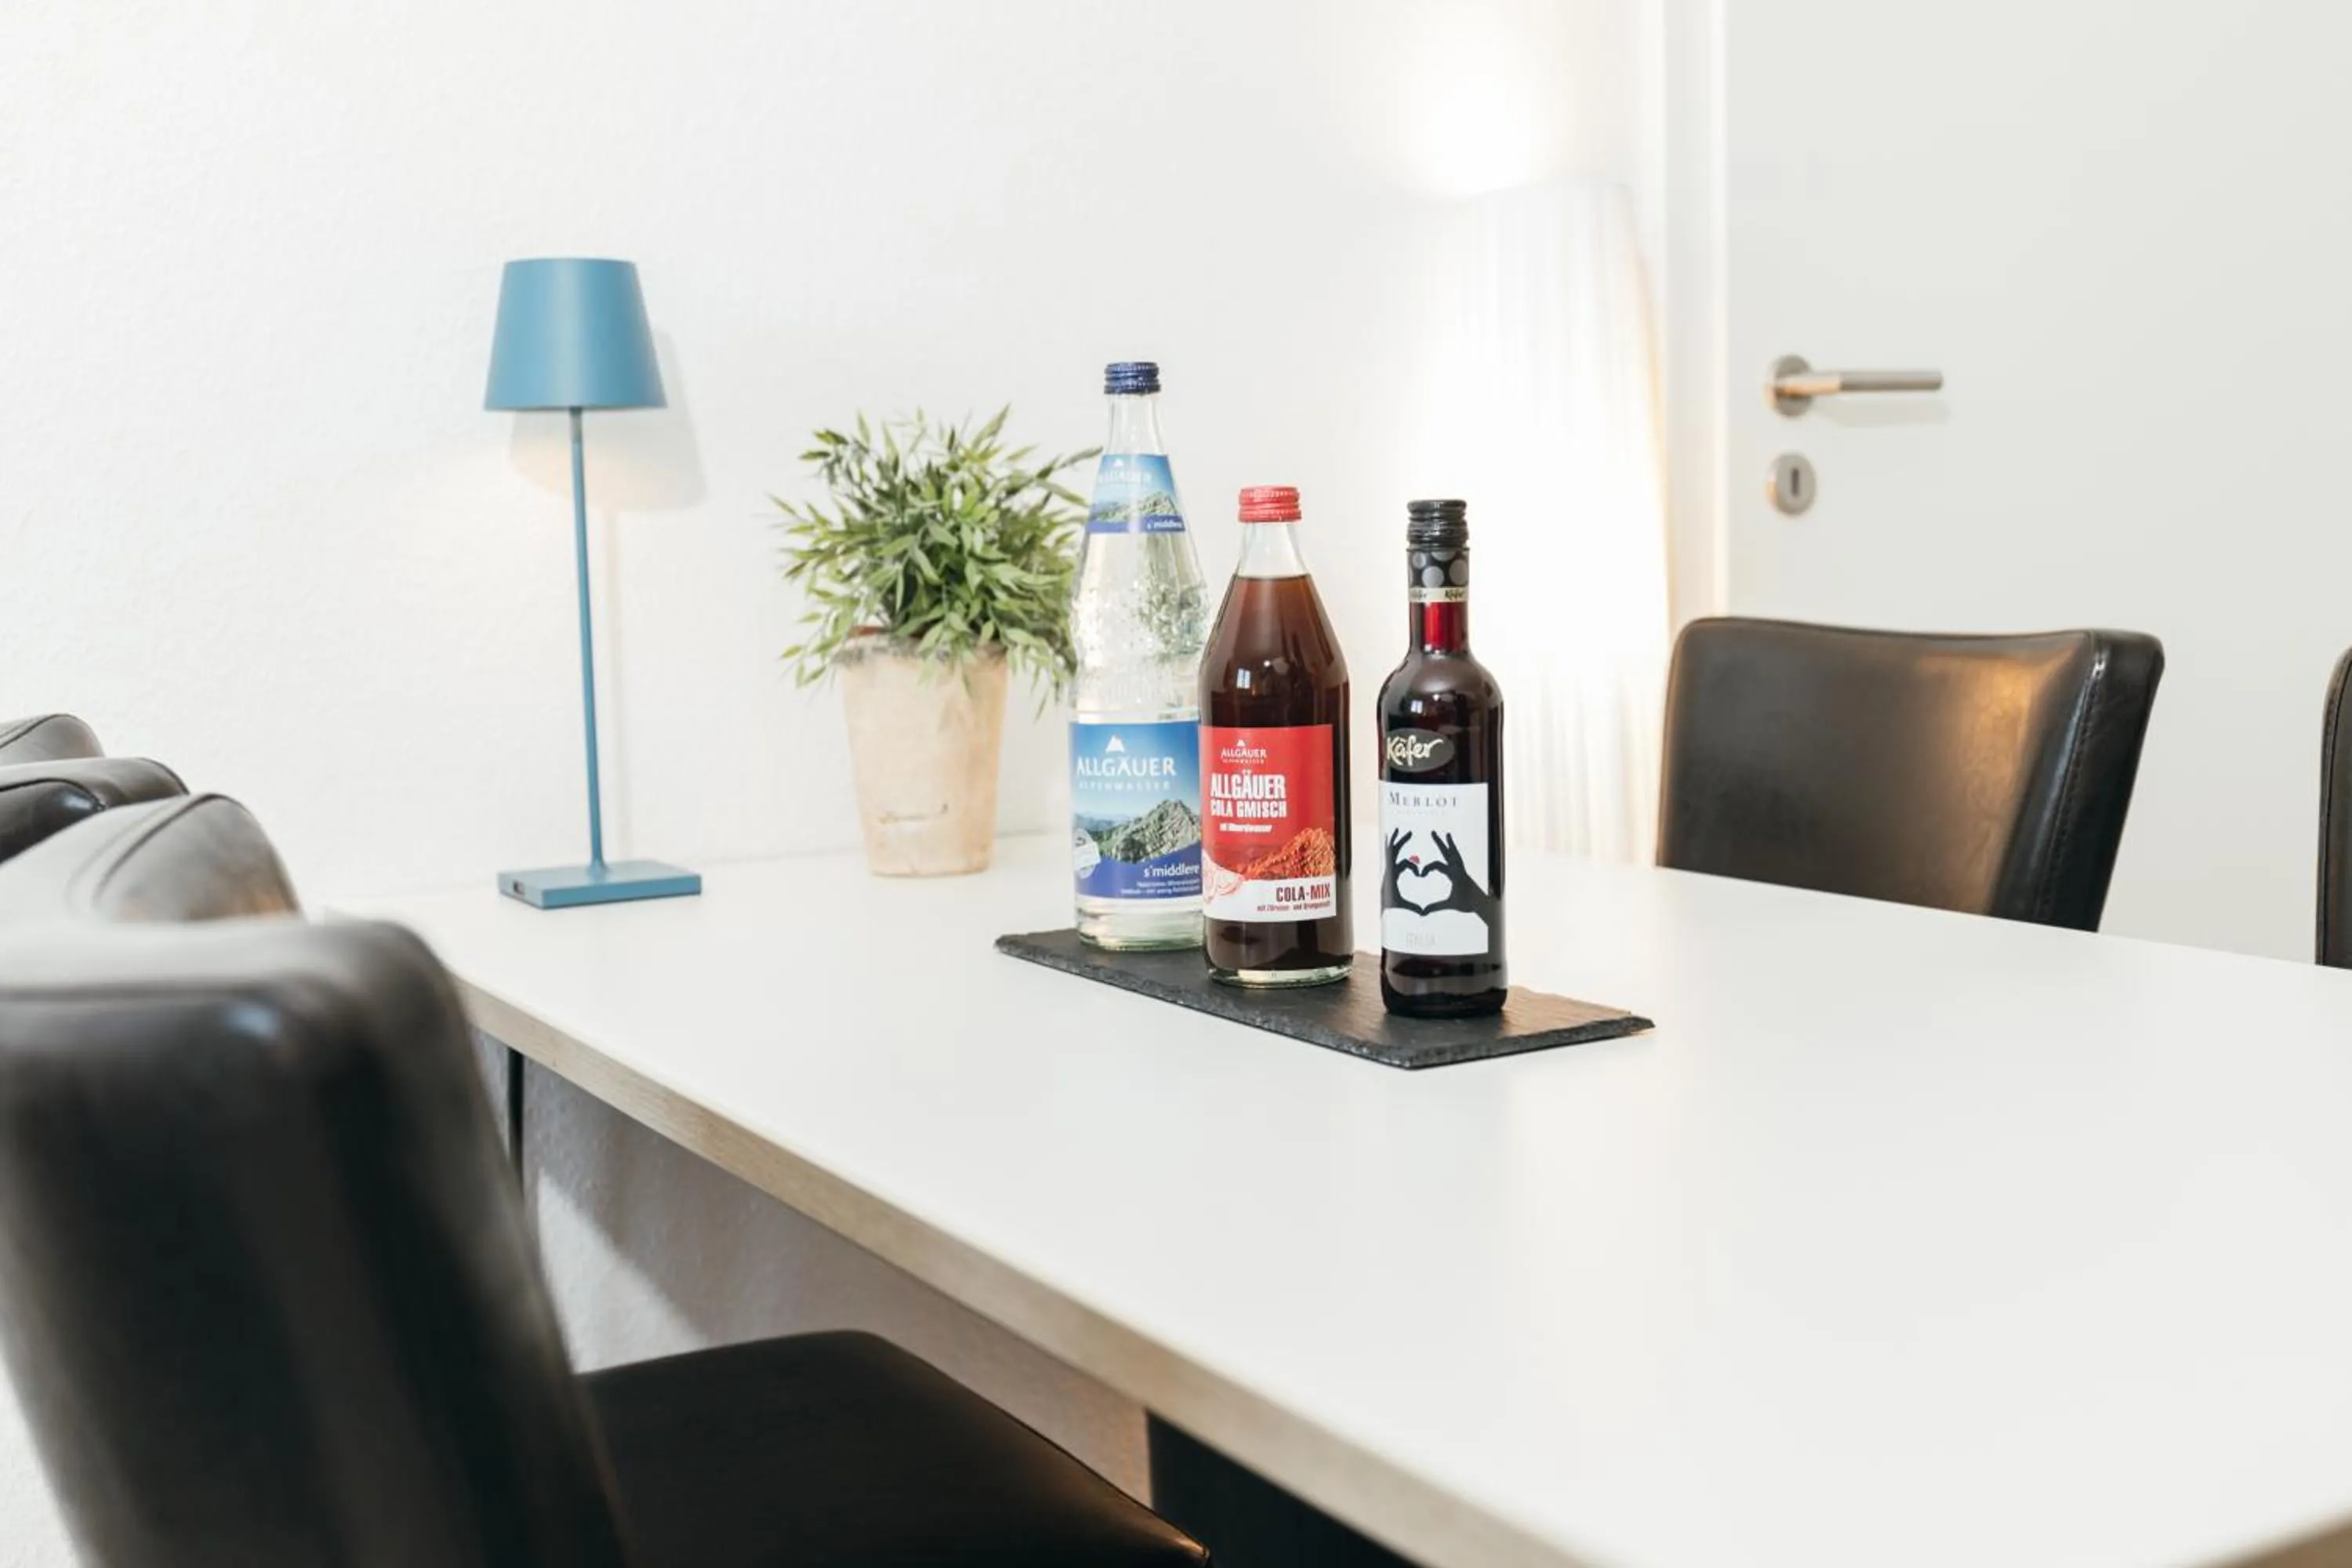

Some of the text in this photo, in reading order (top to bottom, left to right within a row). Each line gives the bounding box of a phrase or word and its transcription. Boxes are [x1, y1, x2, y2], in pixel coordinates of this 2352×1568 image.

[1221, 747, 1267, 759] ALLGÄUER
[1387, 735, 1443, 766] Käfer
[1076, 755, 1177, 777] ALLGÄUER
[1210, 769, 1287, 800] ALLGÄUER
[1210, 799, 1287, 818] COLA GMISCH
[1276, 883, 1330, 902] COLA-MIX
